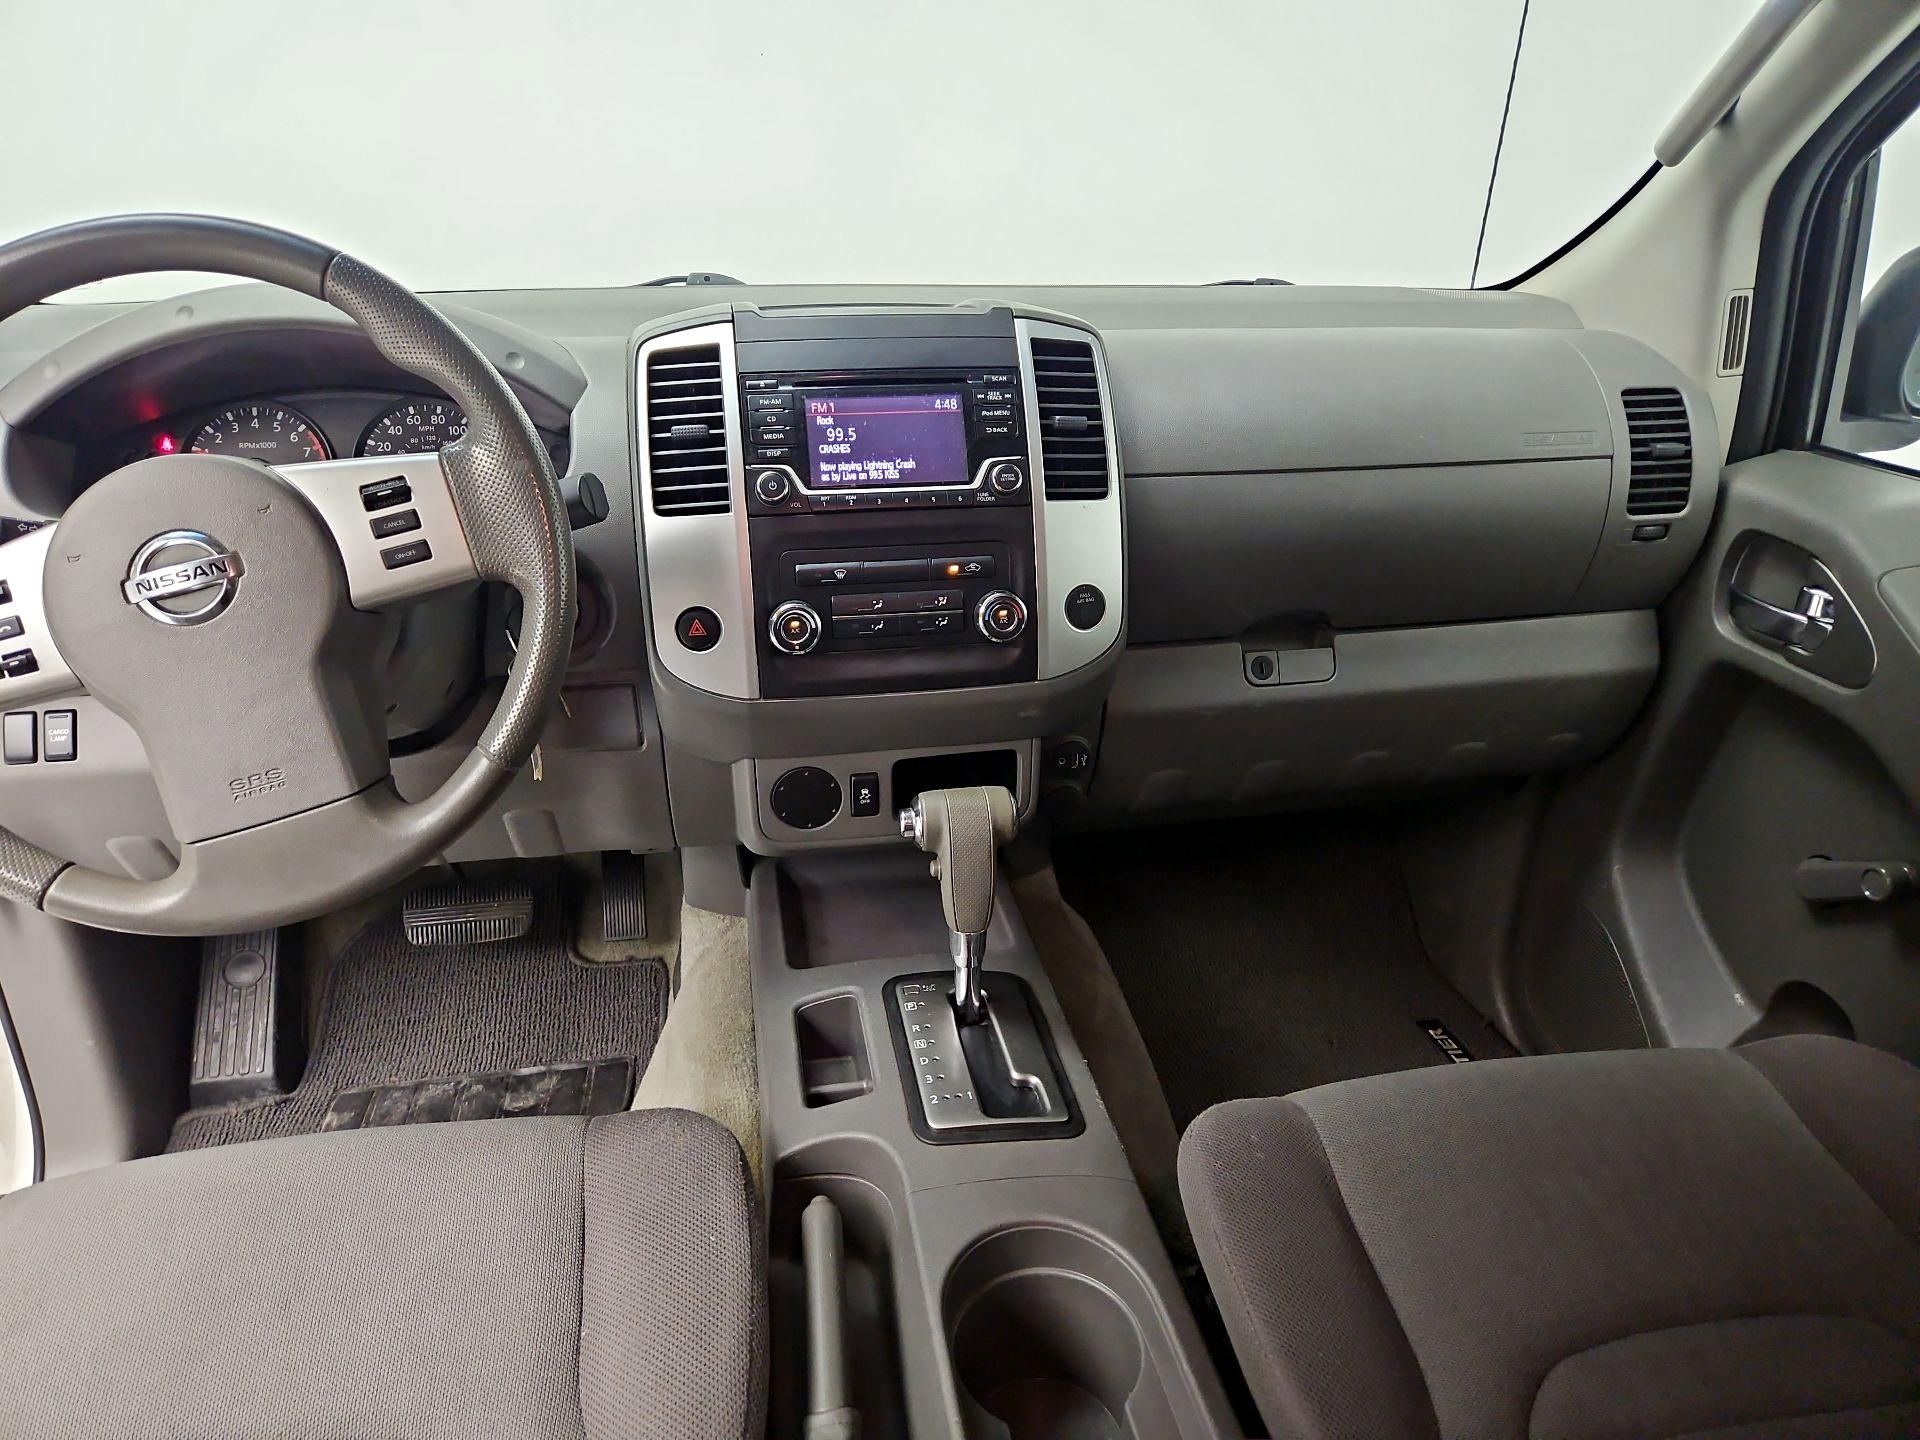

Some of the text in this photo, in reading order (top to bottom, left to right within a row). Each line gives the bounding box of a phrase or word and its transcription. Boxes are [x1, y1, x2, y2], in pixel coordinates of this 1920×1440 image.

[811, 401, 835, 414] FM 1
[934, 398, 958, 410] 4:48
[250, 418, 259, 429] 4
[406, 415, 421, 425] 60
[430, 415, 446, 425] 80
[816, 415, 835, 426] Rock
[232, 422, 239, 433] 3
[273, 421, 281, 432] 5
[387, 425, 403, 435] 40
[448, 425, 467, 436] 100
[214, 432, 222, 444] 2
[290, 431, 299, 443] 6
[826, 427, 857, 442] 99.5
[377, 441, 392, 452] 20
[818, 443, 851, 454] CRASHES
[303, 447, 311, 458] 7
[820, 458, 916, 472] Now playing Lightning Crash
[831, 471, 841, 482] by
[842, 471, 857, 481] Live
[884, 469, 900, 479] KISS
[383, 519, 406, 529] CANCEL
[135, 560, 228, 595] NISSAN
[48, 728, 69, 736] CARGO
[229, 768, 283, 790] SRS
[912, 1024, 921, 1032] R
[920, 1057, 929, 1065] D
[924, 1075, 933, 1084] 3
[930, 1091, 973, 1104] 2 1
